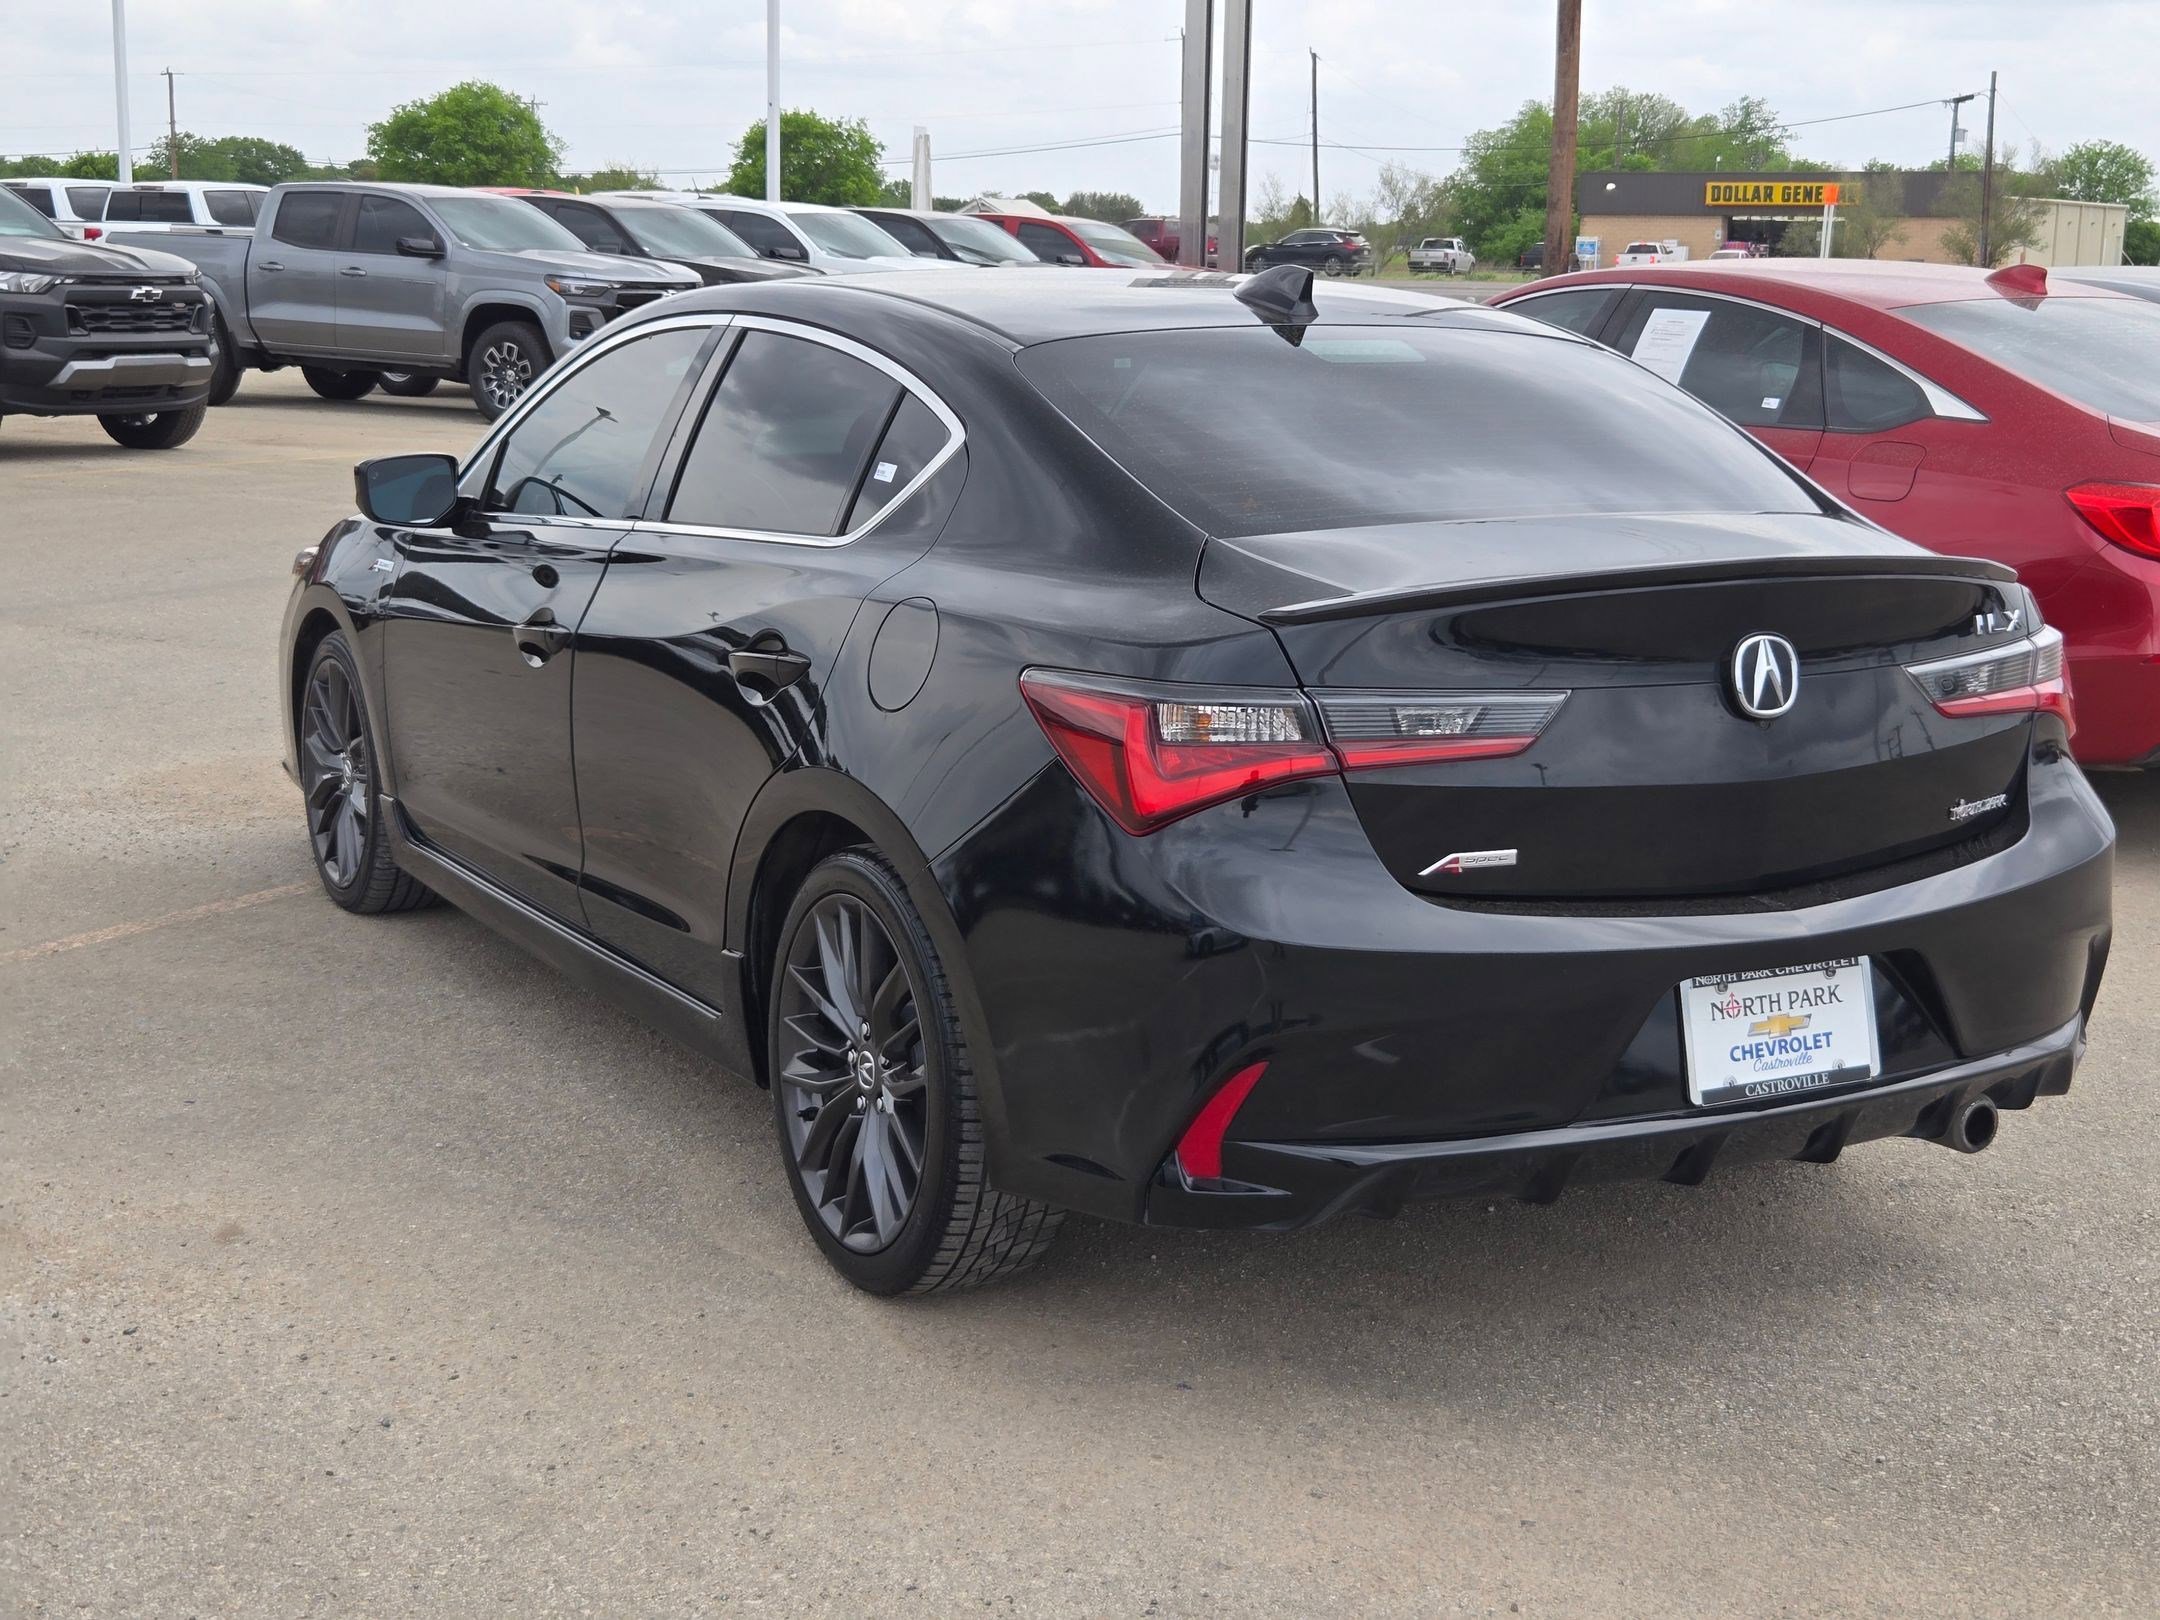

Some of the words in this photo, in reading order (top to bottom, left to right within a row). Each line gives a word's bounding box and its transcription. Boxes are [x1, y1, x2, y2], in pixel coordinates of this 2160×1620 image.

[1711, 185, 1774, 203] DOLLAR
[1781, 185, 1857, 203] GENE
[1975, 609, 2021, 635] ILX
[1695, 973, 1737, 986] NORTH
[1711, 992, 1782, 1021] NORTH
[1788, 984, 1844, 1010] PARK
[1729, 1031, 1833, 1062] CHEVROLET
[1753, 1052, 1814, 1073] Castroville
[1745, 1072, 1830, 1097] CASTROVILLE
